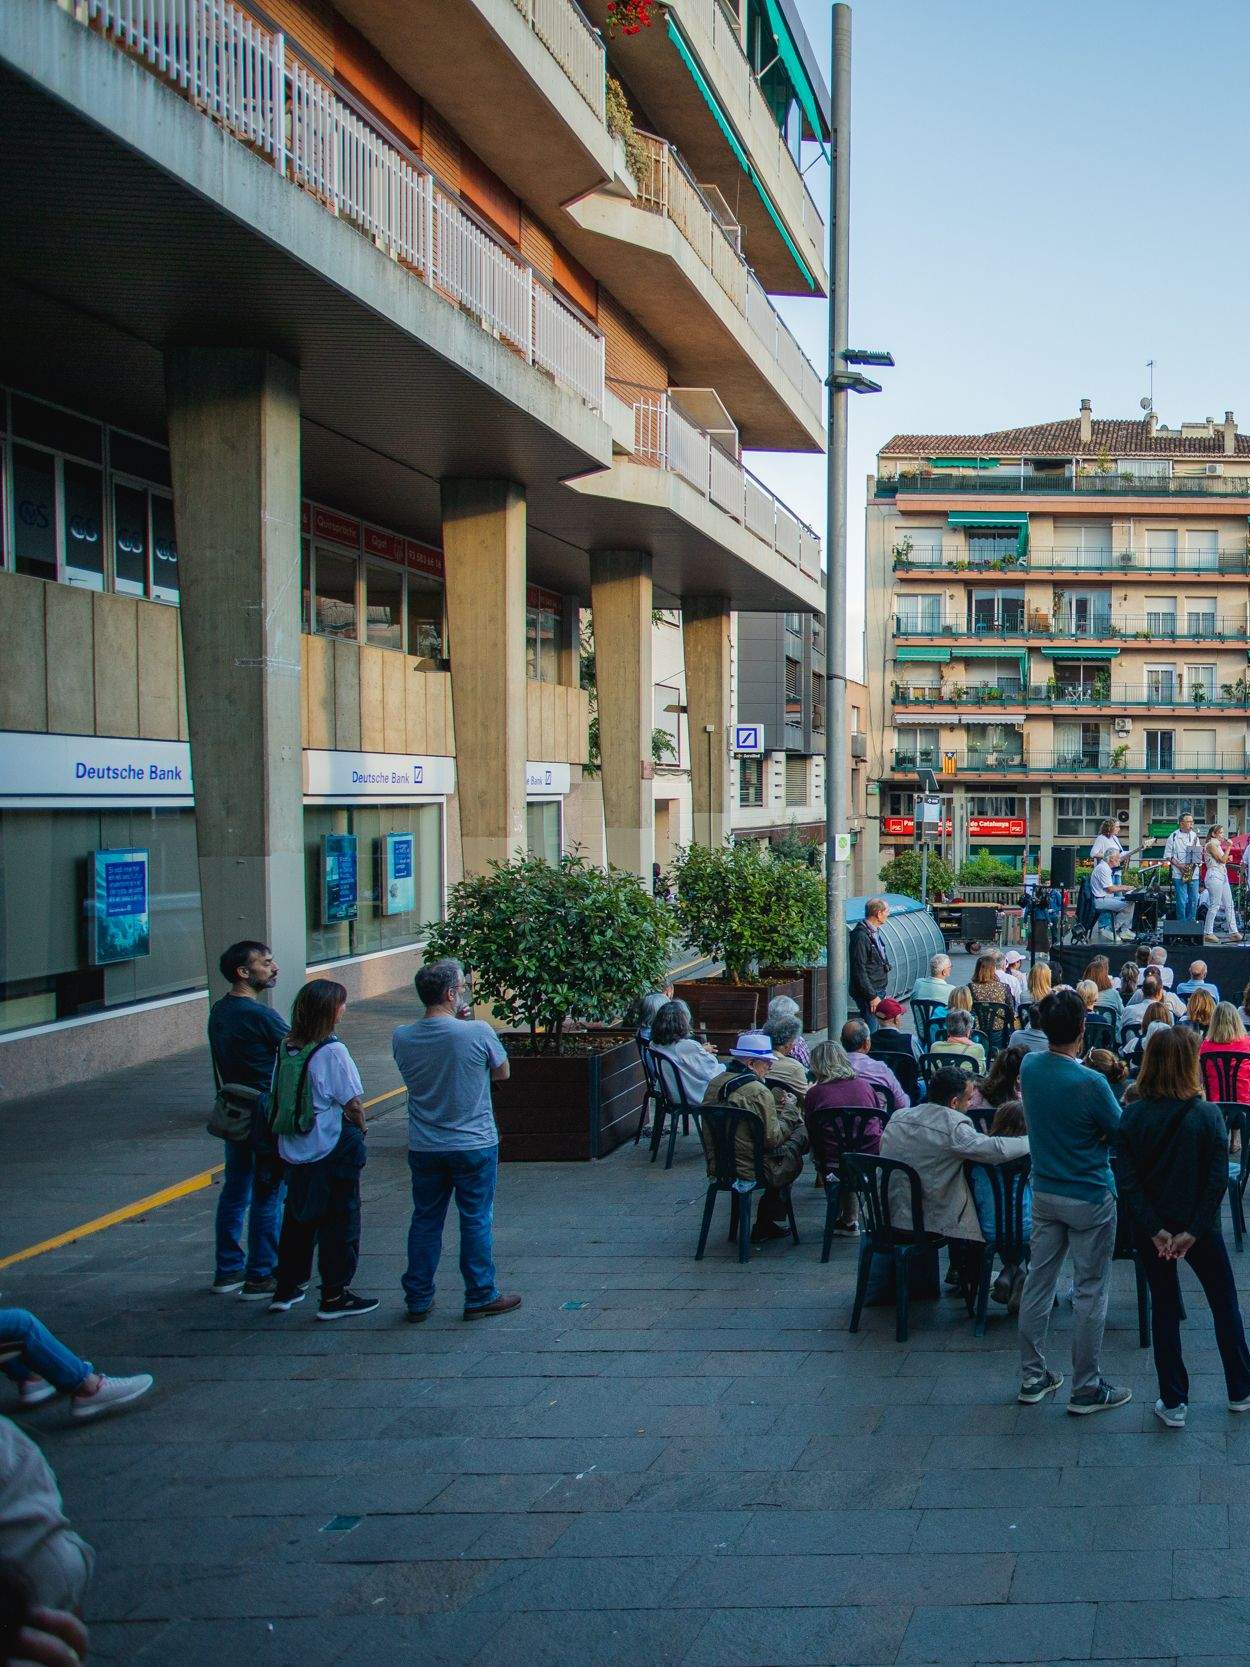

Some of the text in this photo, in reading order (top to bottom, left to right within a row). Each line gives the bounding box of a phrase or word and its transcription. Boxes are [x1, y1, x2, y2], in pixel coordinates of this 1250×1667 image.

[75, 762, 182, 780] Deutsche Bank
[352, 770, 410, 785] Deutsche Bank
[530, 777, 543, 786] Bank
[979, 820, 1010, 829] Catalunya
